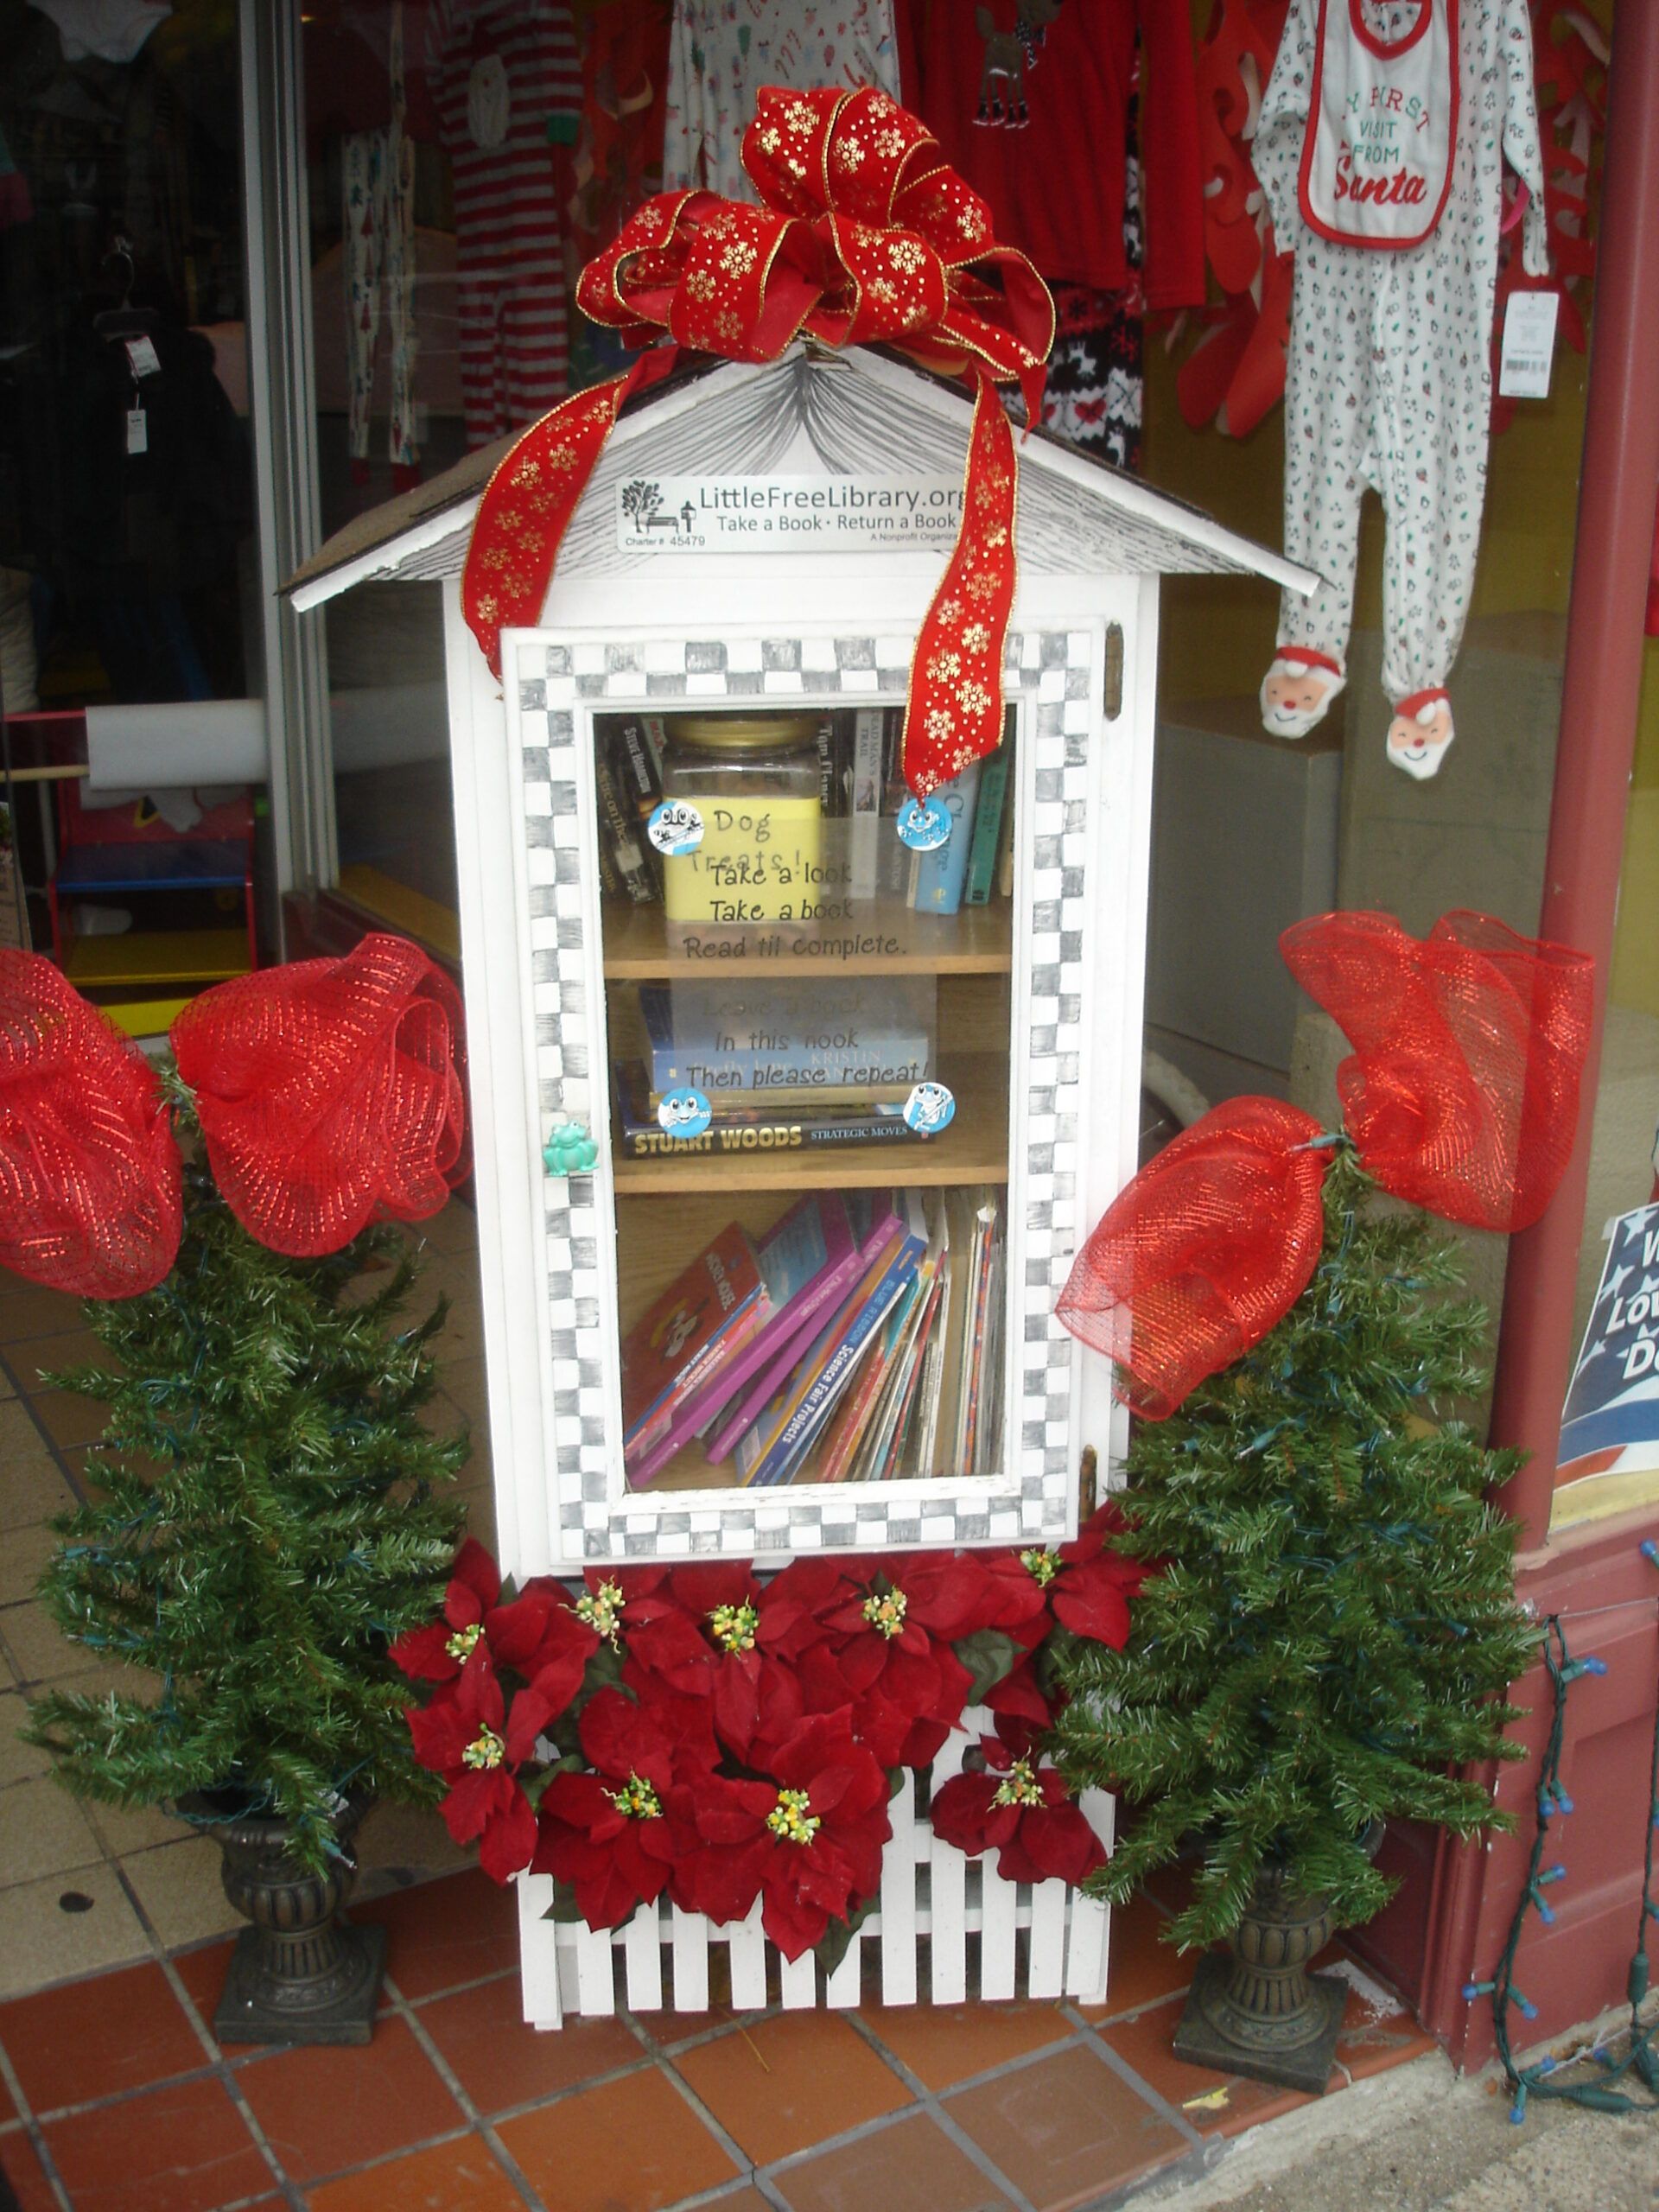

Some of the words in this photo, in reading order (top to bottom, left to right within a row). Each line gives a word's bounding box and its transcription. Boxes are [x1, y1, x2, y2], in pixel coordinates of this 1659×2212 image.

[1342, 91, 1360, 114] Y
[1359, 120, 1398, 139] VISIT
[1352, 144, 1400, 165] FROM
[1333, 155, 1427, 206] Santa
[717, 515, 758, 531] Take
[764, 519, 773, 531] a
[779, 514, 822, 531] Book
[837, 513, 894, 531] Return
[899, 518, 909, 529] a
[915, 512, 957, 529] Book
[625, 537, 657, 547] Charter
[670, 536, 706, 547] 45479
[879, 532, 918, 543] Nonprofit
[817, 724, 833, 755] Tom
[859, 728, 869, 758] TRAIL
[624, 727, 639, 754] STEVE
[632, 753, 652, 793] HAMILTON
[714, 810, 771, 843] Dog
[688, 849, 802, 874] Treats!
[710, 863, 767, 887] Take
[779, 867, 792, 884] a
[804, 861, 853, 884] look
[710, 899, 766, 922] Take
[779, 904, 792, 921] a
[800, 899, 854, 920] book
[683, 937, 747, 958] Read
[715, 1032, 734, 1052] In
[748, 1029, 789, 1051] this
[804, 1027, 859, 1050] nook
[810, 1049, 881, 1065] KRISTIN
[686, 1065, 742, 1088] Then
[753, 1065, 826, 1090] please
[843, 1062, 930, 1088] repeat!
[635, 1129, 715, 1155] STUART
[720, 1126, 803, 1151] WOODS
[810, 1127, 869, 1141] STRATEGIC
[871, 1125, 907, 1138] MOVES
[705, 1253, 725, 1285] MICKEY
[716, 1277, 736, 1312] MOUSE
[874, 1280, 895, 1305] BLUE
[849, 1306, 878, 1344] RIBBON
[822, 1344, 855, 1383] Science
[807, 1381, 830, 1408] Fair
[782, 1399, 816, 1448] Projects
